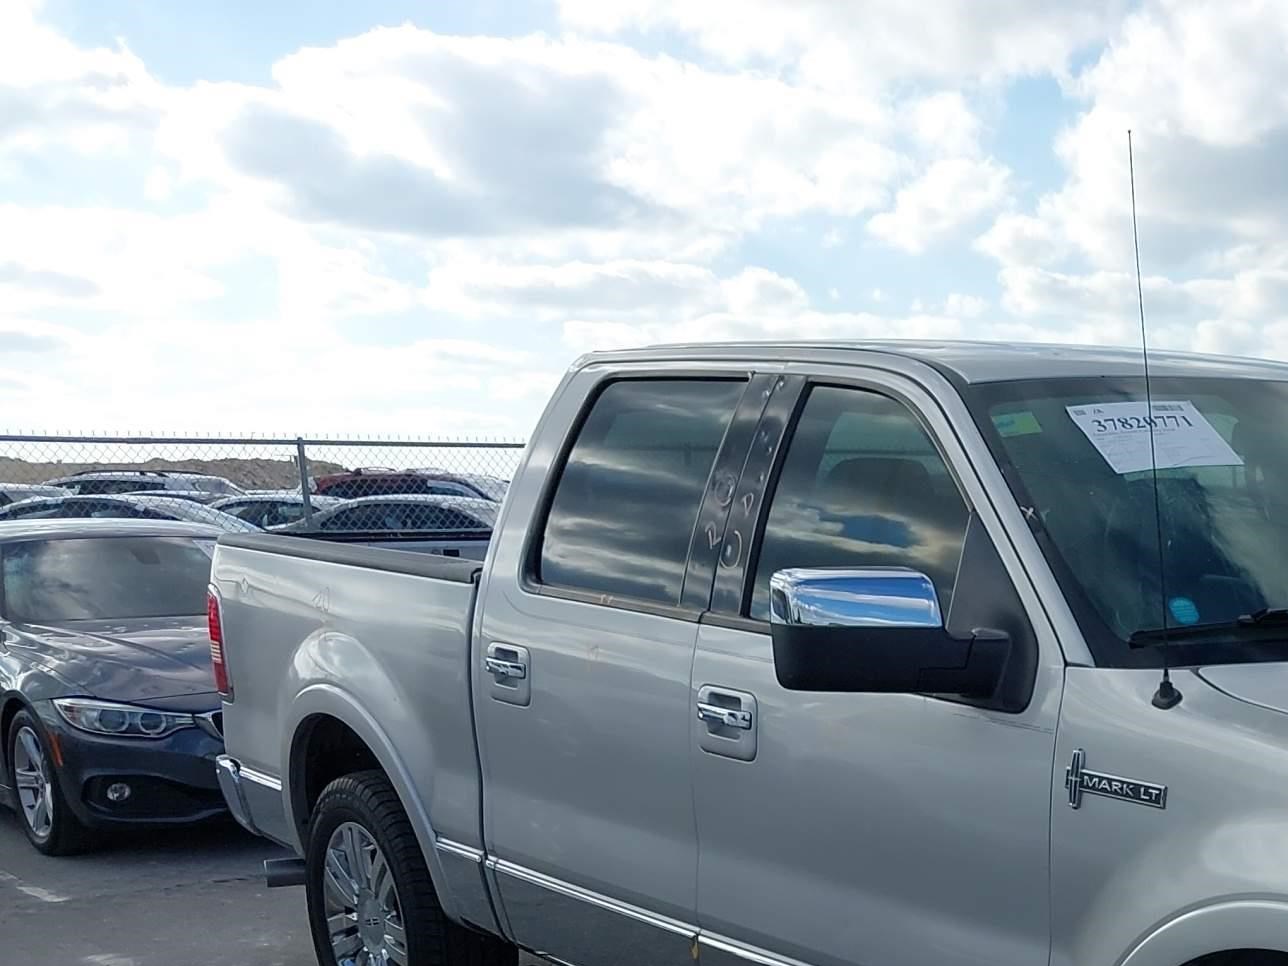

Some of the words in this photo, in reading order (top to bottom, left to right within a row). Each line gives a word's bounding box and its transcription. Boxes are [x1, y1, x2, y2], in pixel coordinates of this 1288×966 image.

[1091, 415, 1193, 433] 37820771
[1083, 775, 1135, 797] MARK
[1140, 787, 1161, 801] LT
